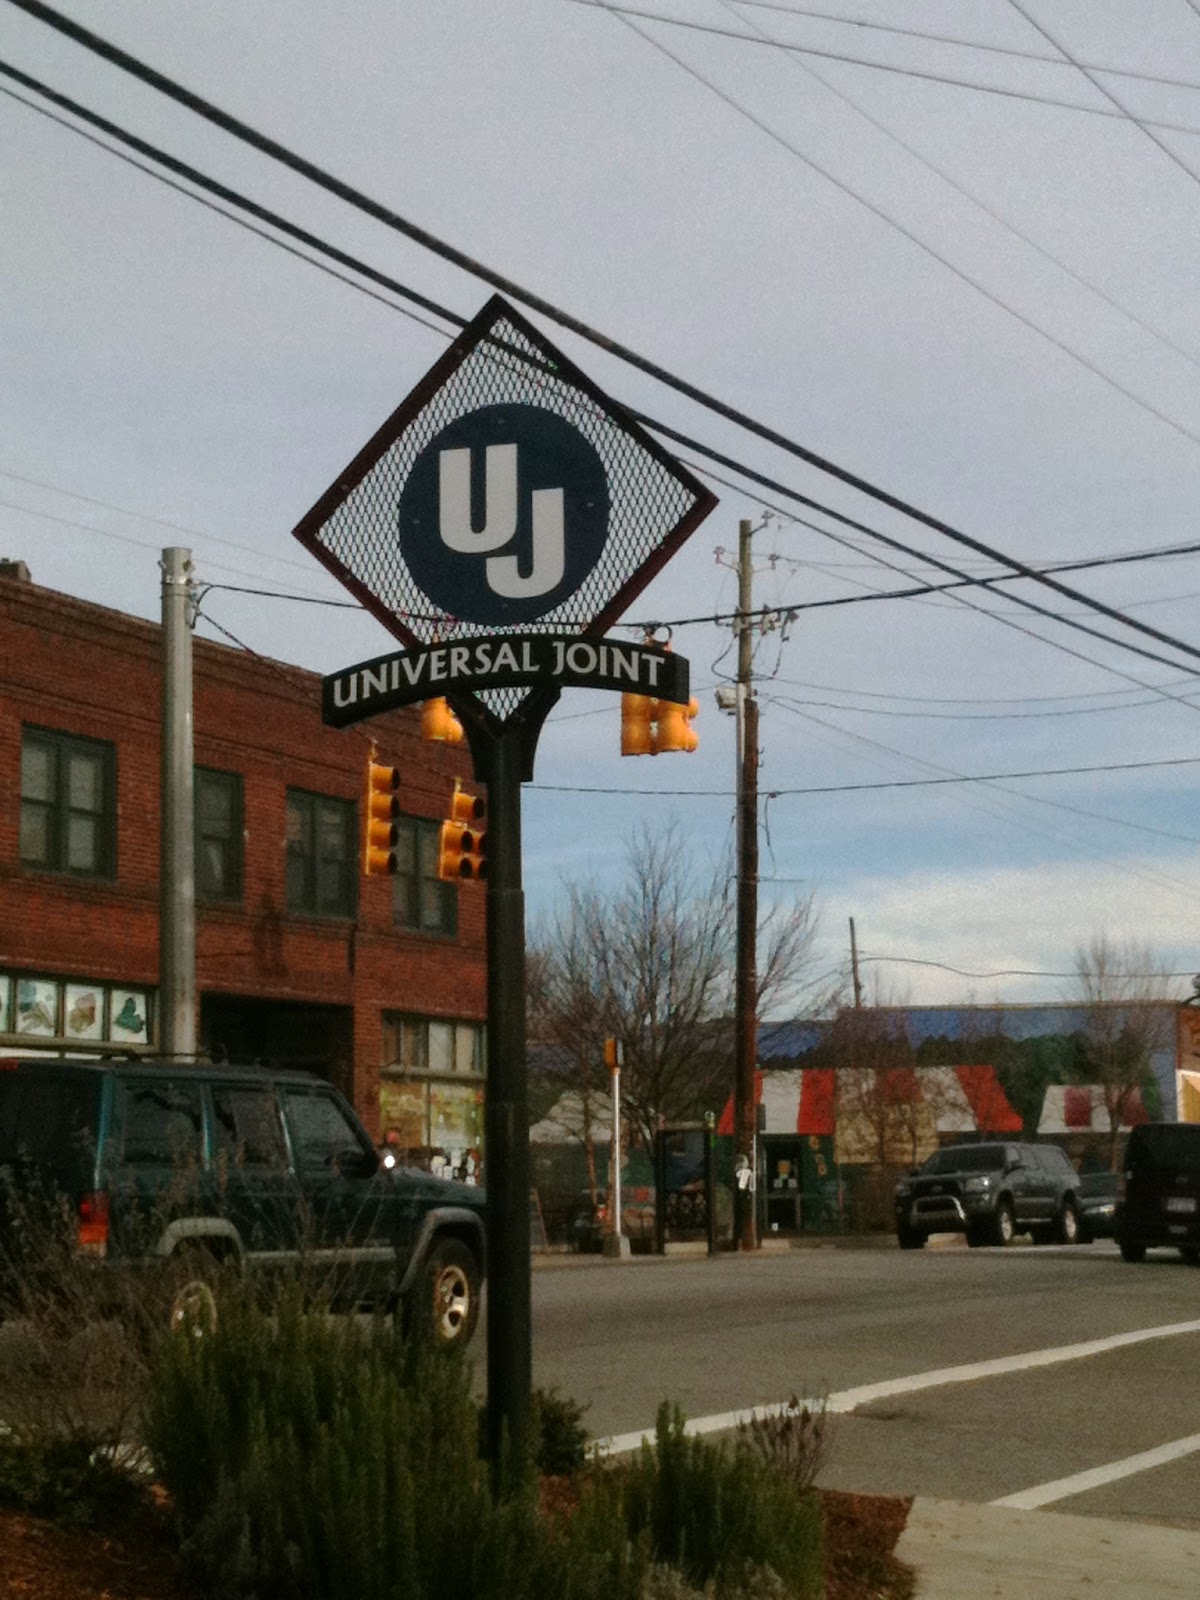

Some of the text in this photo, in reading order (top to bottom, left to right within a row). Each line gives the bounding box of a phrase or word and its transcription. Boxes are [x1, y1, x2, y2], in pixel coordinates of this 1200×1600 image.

[439, 443, 565, 598] UJ
[333, 641, 665, 708] UNIVERSAL JOINT
